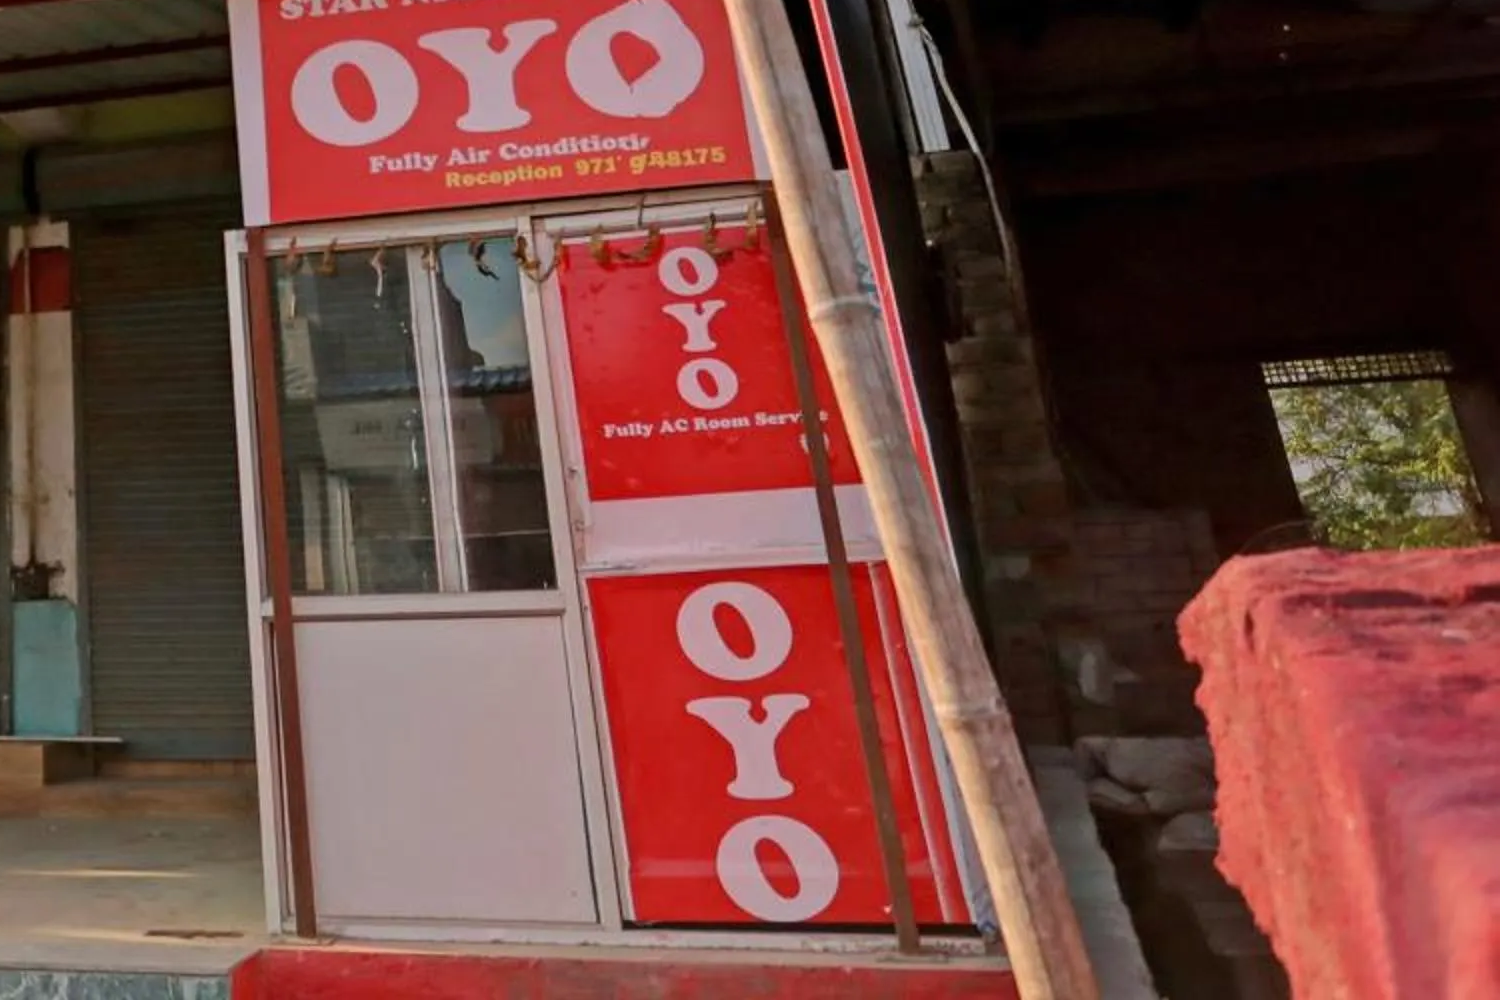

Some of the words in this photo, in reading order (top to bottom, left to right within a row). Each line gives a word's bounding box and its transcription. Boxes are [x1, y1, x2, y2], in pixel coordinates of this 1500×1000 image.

[369, 153, 440, 175] Fully
[448, 147, 491, 166] Air
[444, 162, 564, 188] Reception
[658, 246, 739, 409] OYO
[603, 421, 653, 438] Fully
[660, 418, 689, 434] AC
[694, 412, 750, 432] Room
[676, 582, 840, 922] OYO
